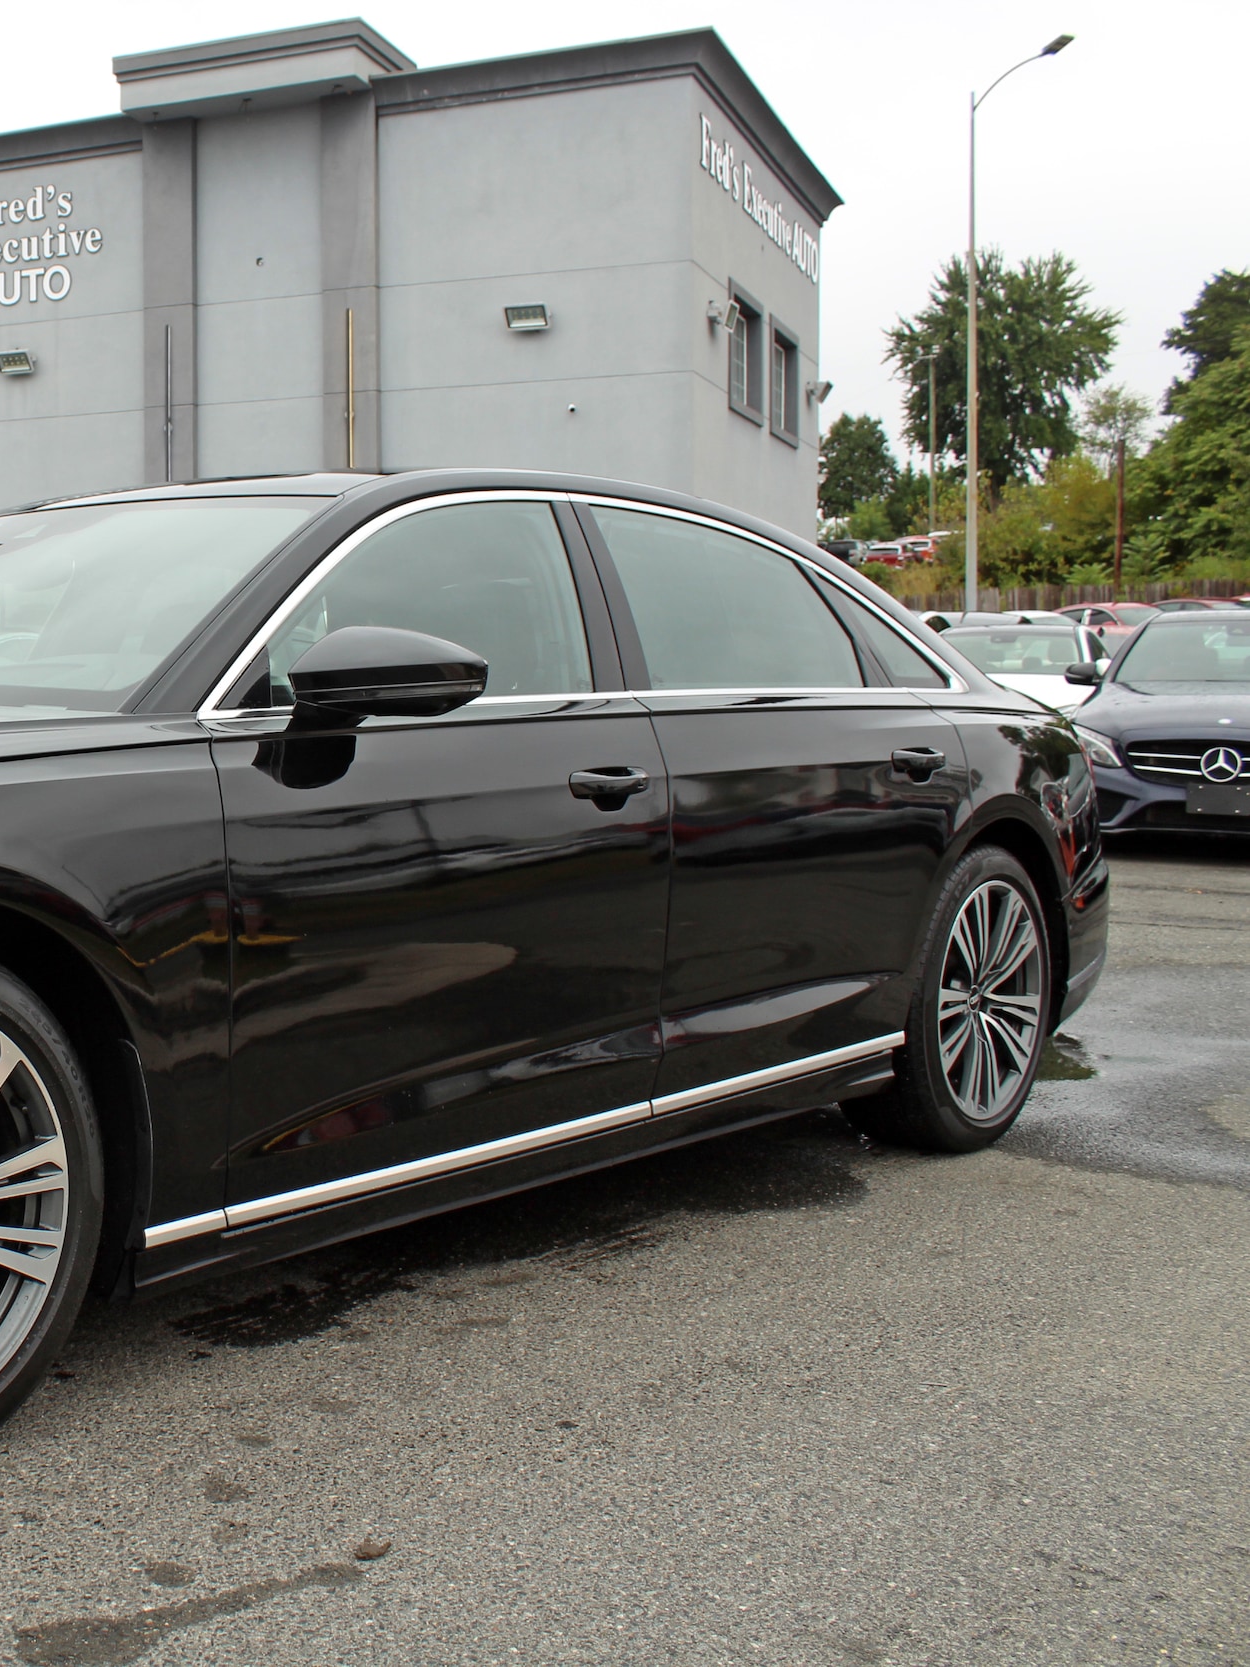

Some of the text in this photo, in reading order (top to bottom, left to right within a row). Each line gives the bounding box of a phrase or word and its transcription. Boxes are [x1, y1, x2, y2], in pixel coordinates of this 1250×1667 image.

[700, 113, 818, 284] Fred's Executive AUTO
